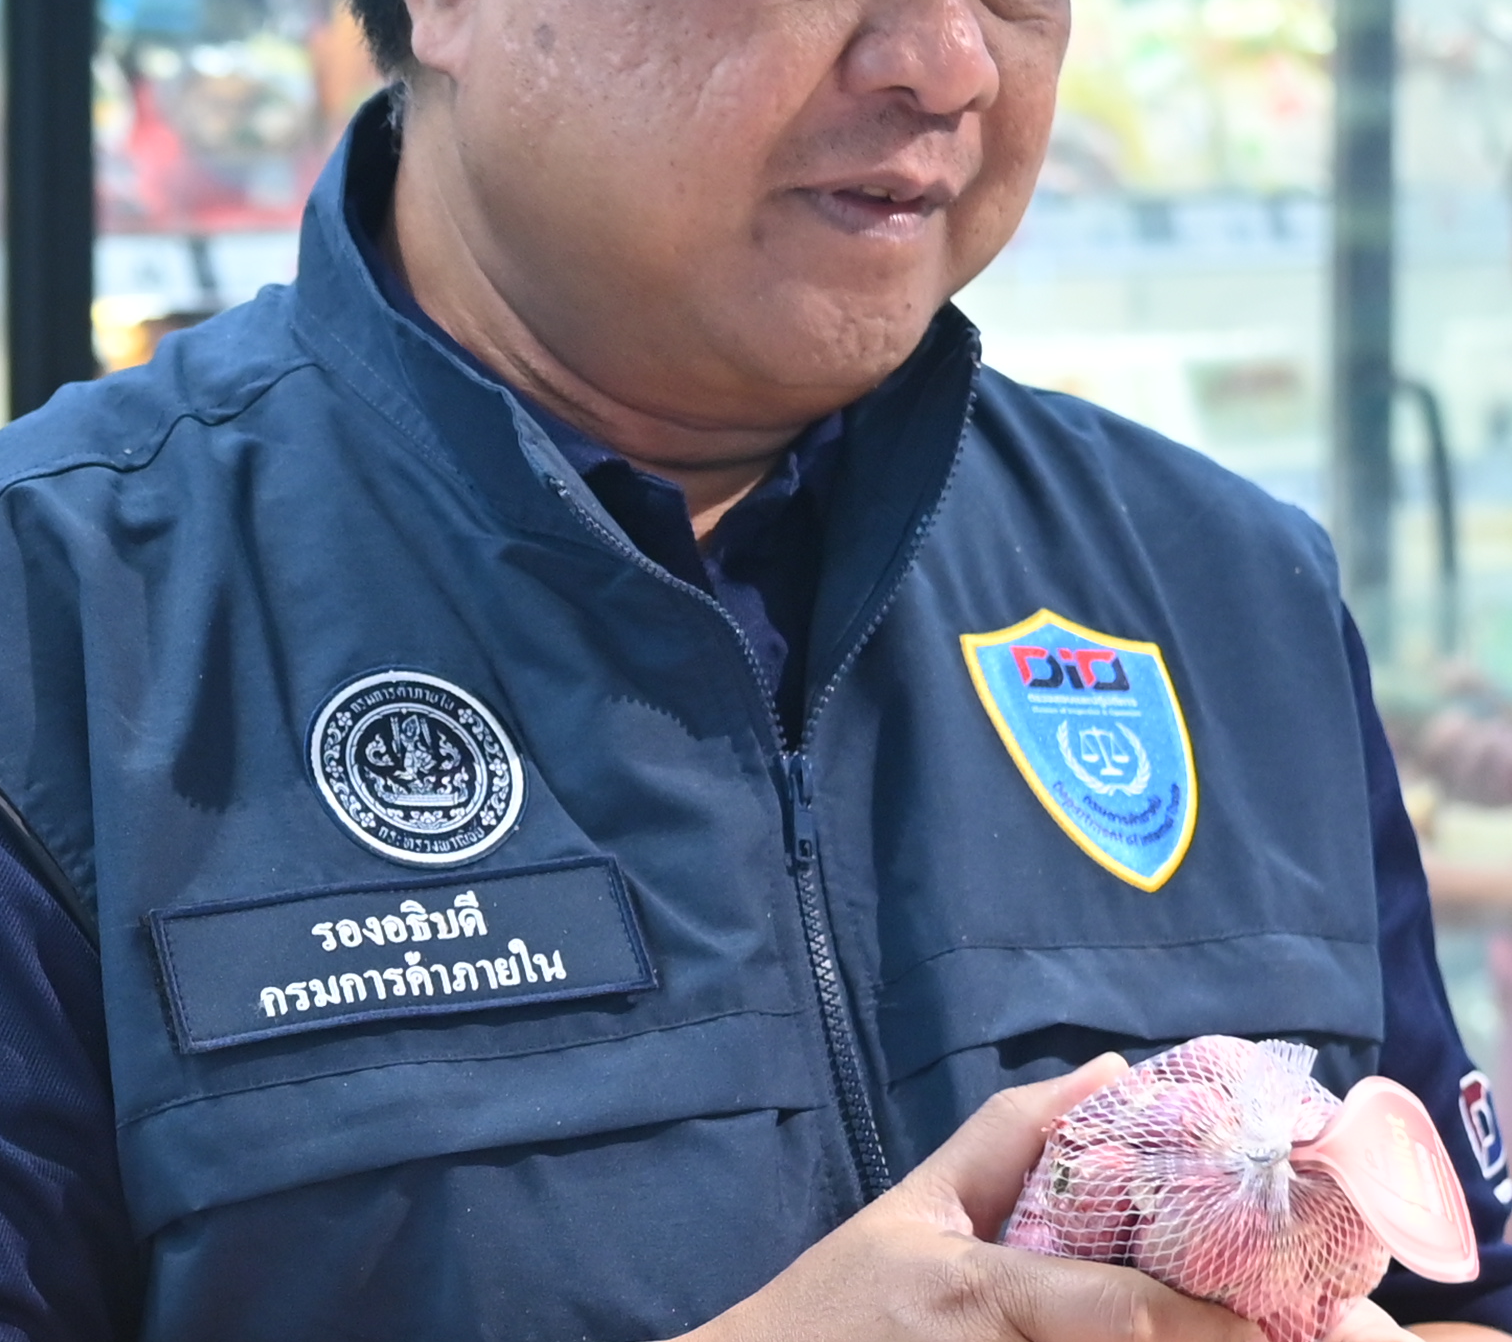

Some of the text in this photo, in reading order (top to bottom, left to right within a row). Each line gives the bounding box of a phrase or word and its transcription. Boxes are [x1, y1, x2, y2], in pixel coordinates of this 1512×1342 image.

[311, 890, 488, 952] รองอธิบดี
[259, 938, 566, 1018] กรมการค้าภายใน
